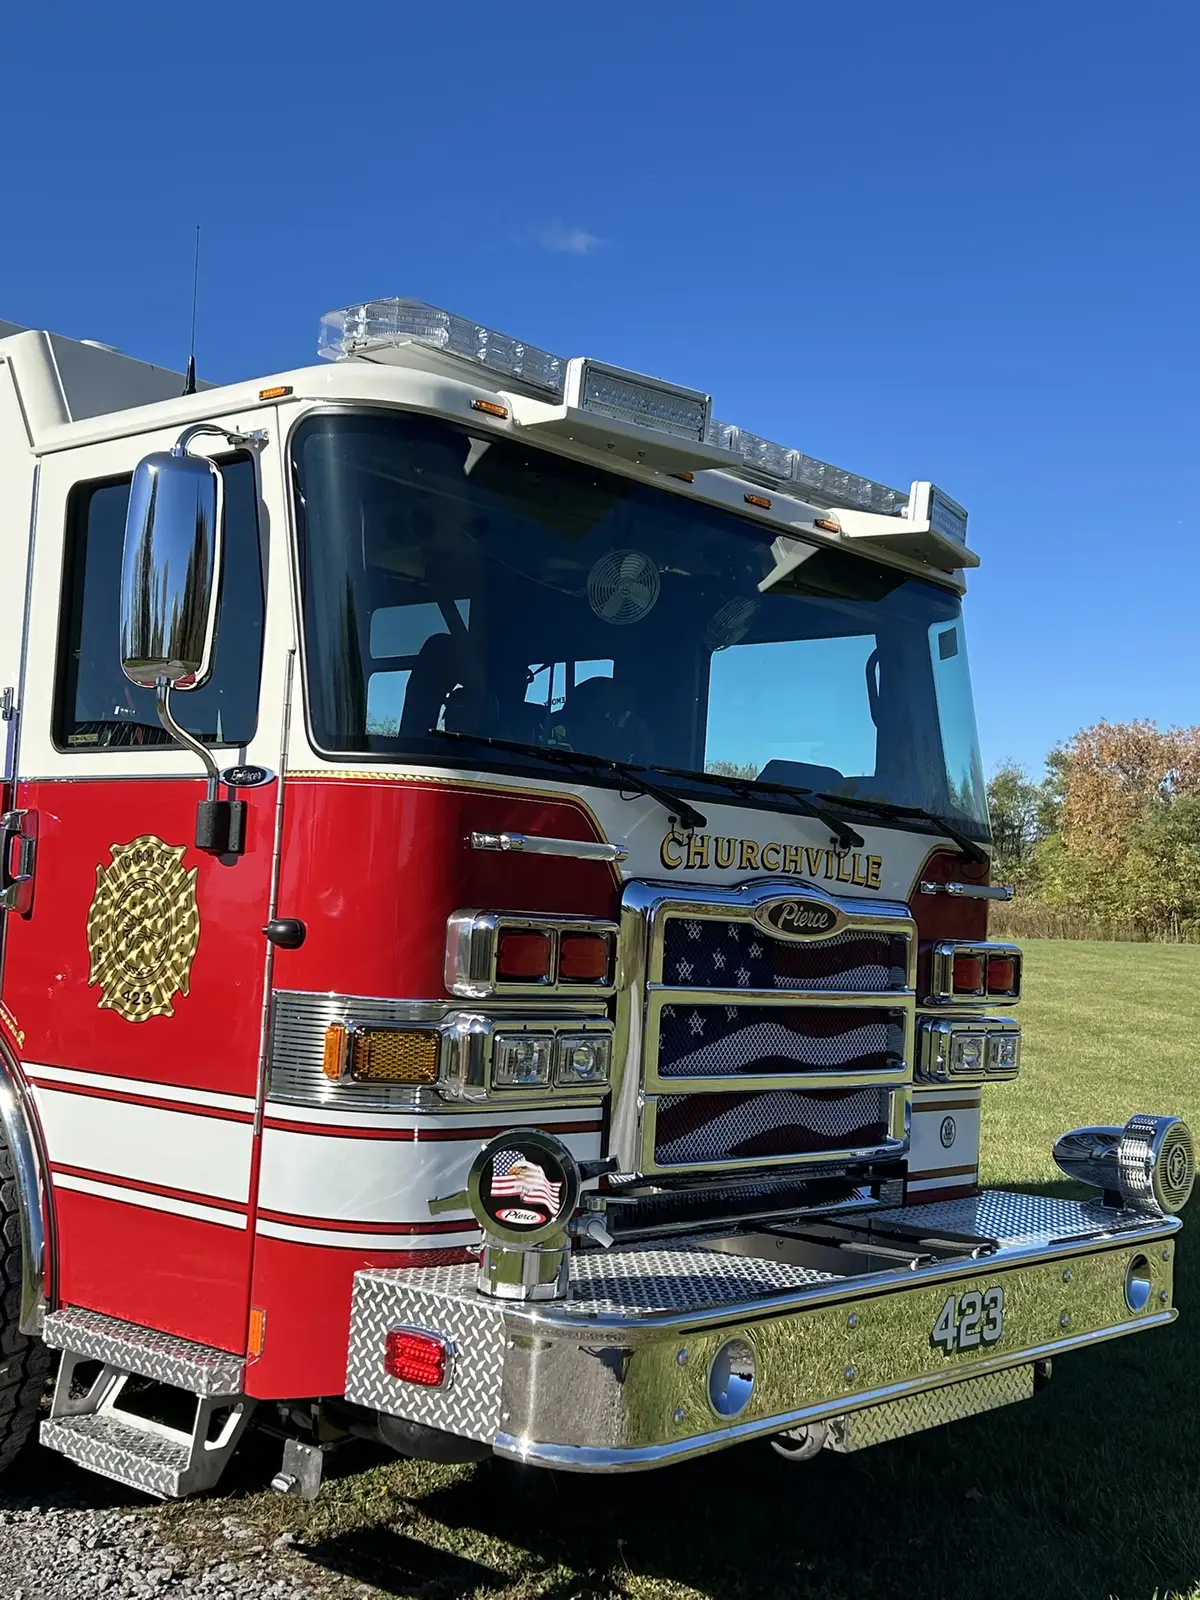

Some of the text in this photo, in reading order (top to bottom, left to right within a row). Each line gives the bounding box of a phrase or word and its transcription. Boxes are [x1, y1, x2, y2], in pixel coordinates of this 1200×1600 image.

[123, 848, 171, 868] CHURCHLLE
[660, 831, 883, 890] CHURCHVILLE
[777, 902, 829, 929] Pierce
[121, 990, 153, 1005] 423
[504, 1210, 537, 1221] Pierce
[929, 1285, 1005, 1357] 423
